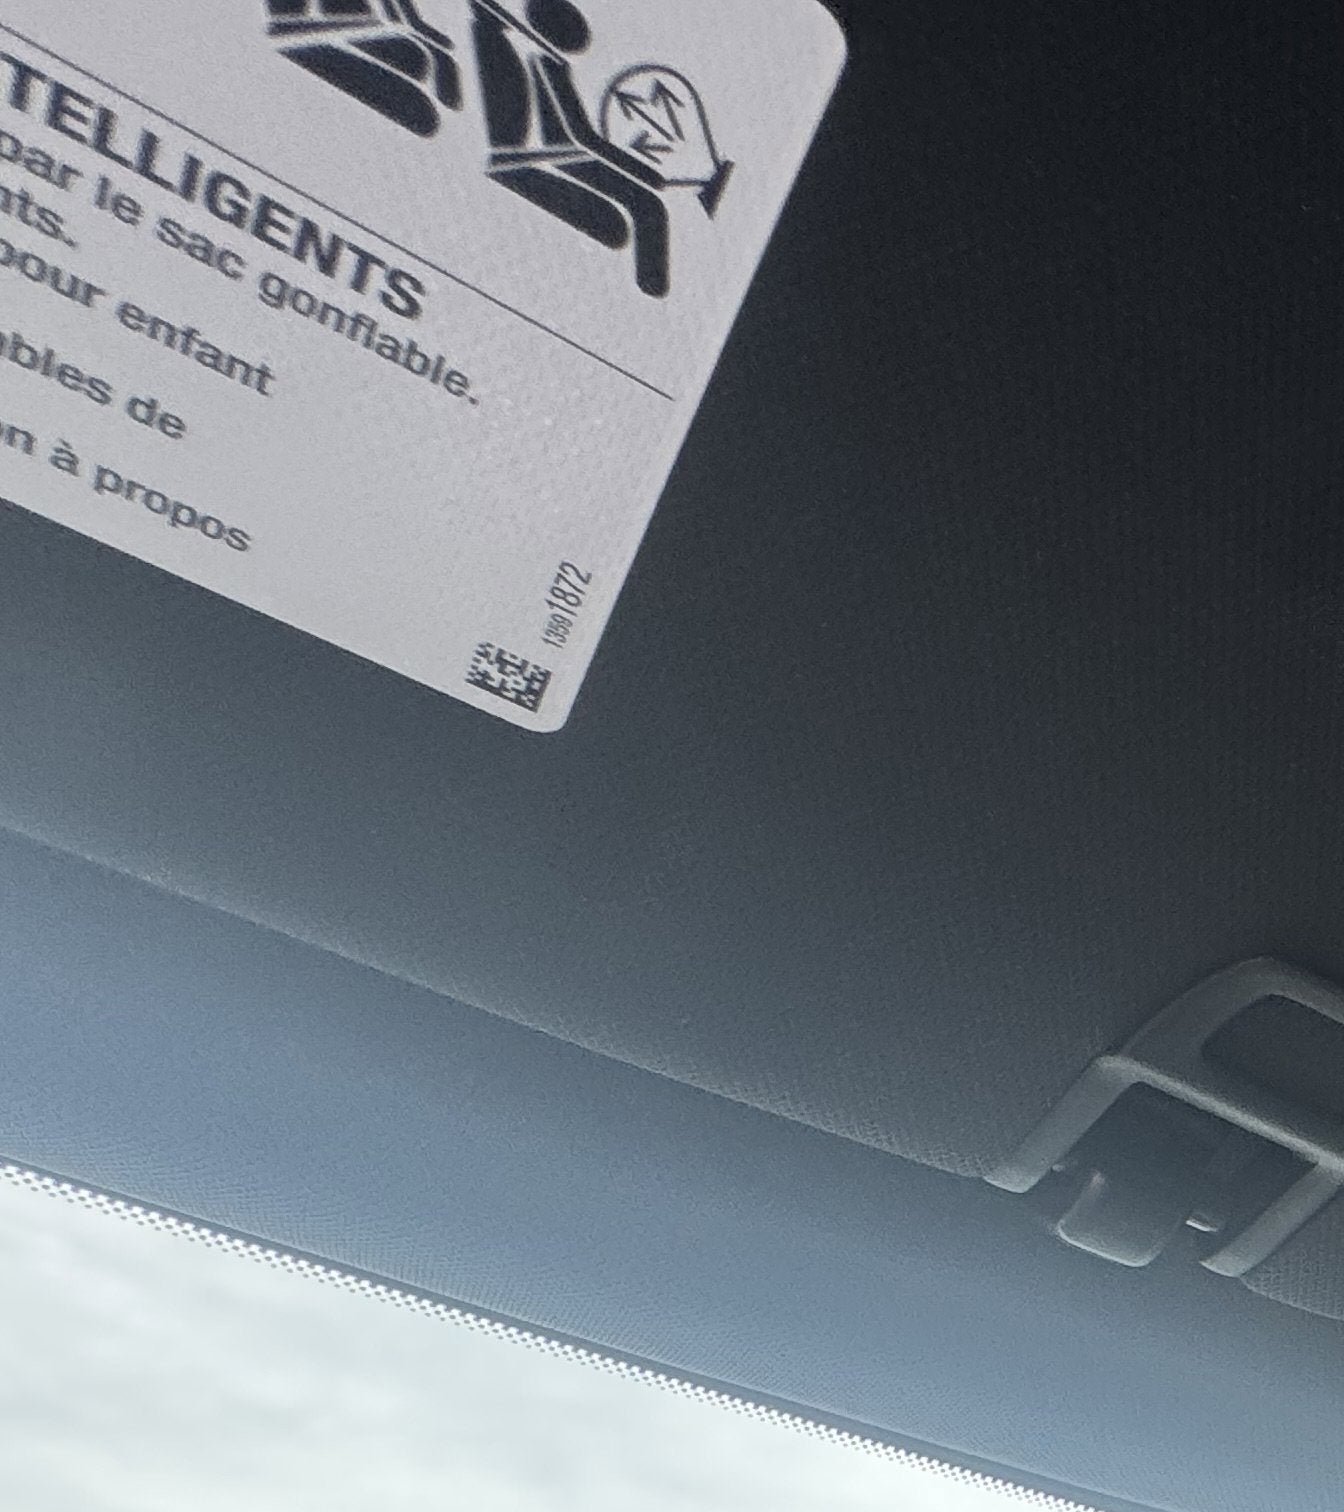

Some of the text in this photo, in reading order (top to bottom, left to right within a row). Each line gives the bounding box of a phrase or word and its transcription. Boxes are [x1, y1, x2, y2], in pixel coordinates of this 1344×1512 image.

[0, 52, 427, 321] TELLIGENTS
[94, 174, 145, 227] le
[156, 215, 248, 281] sac
[258, 270, 479, 406] gonfiable.
[0, 331, 187, 439] bles de
[114, 300, 276, 397] enfant
[48, 437, 80, 478] à
[93, 464, 253, 552] propos
